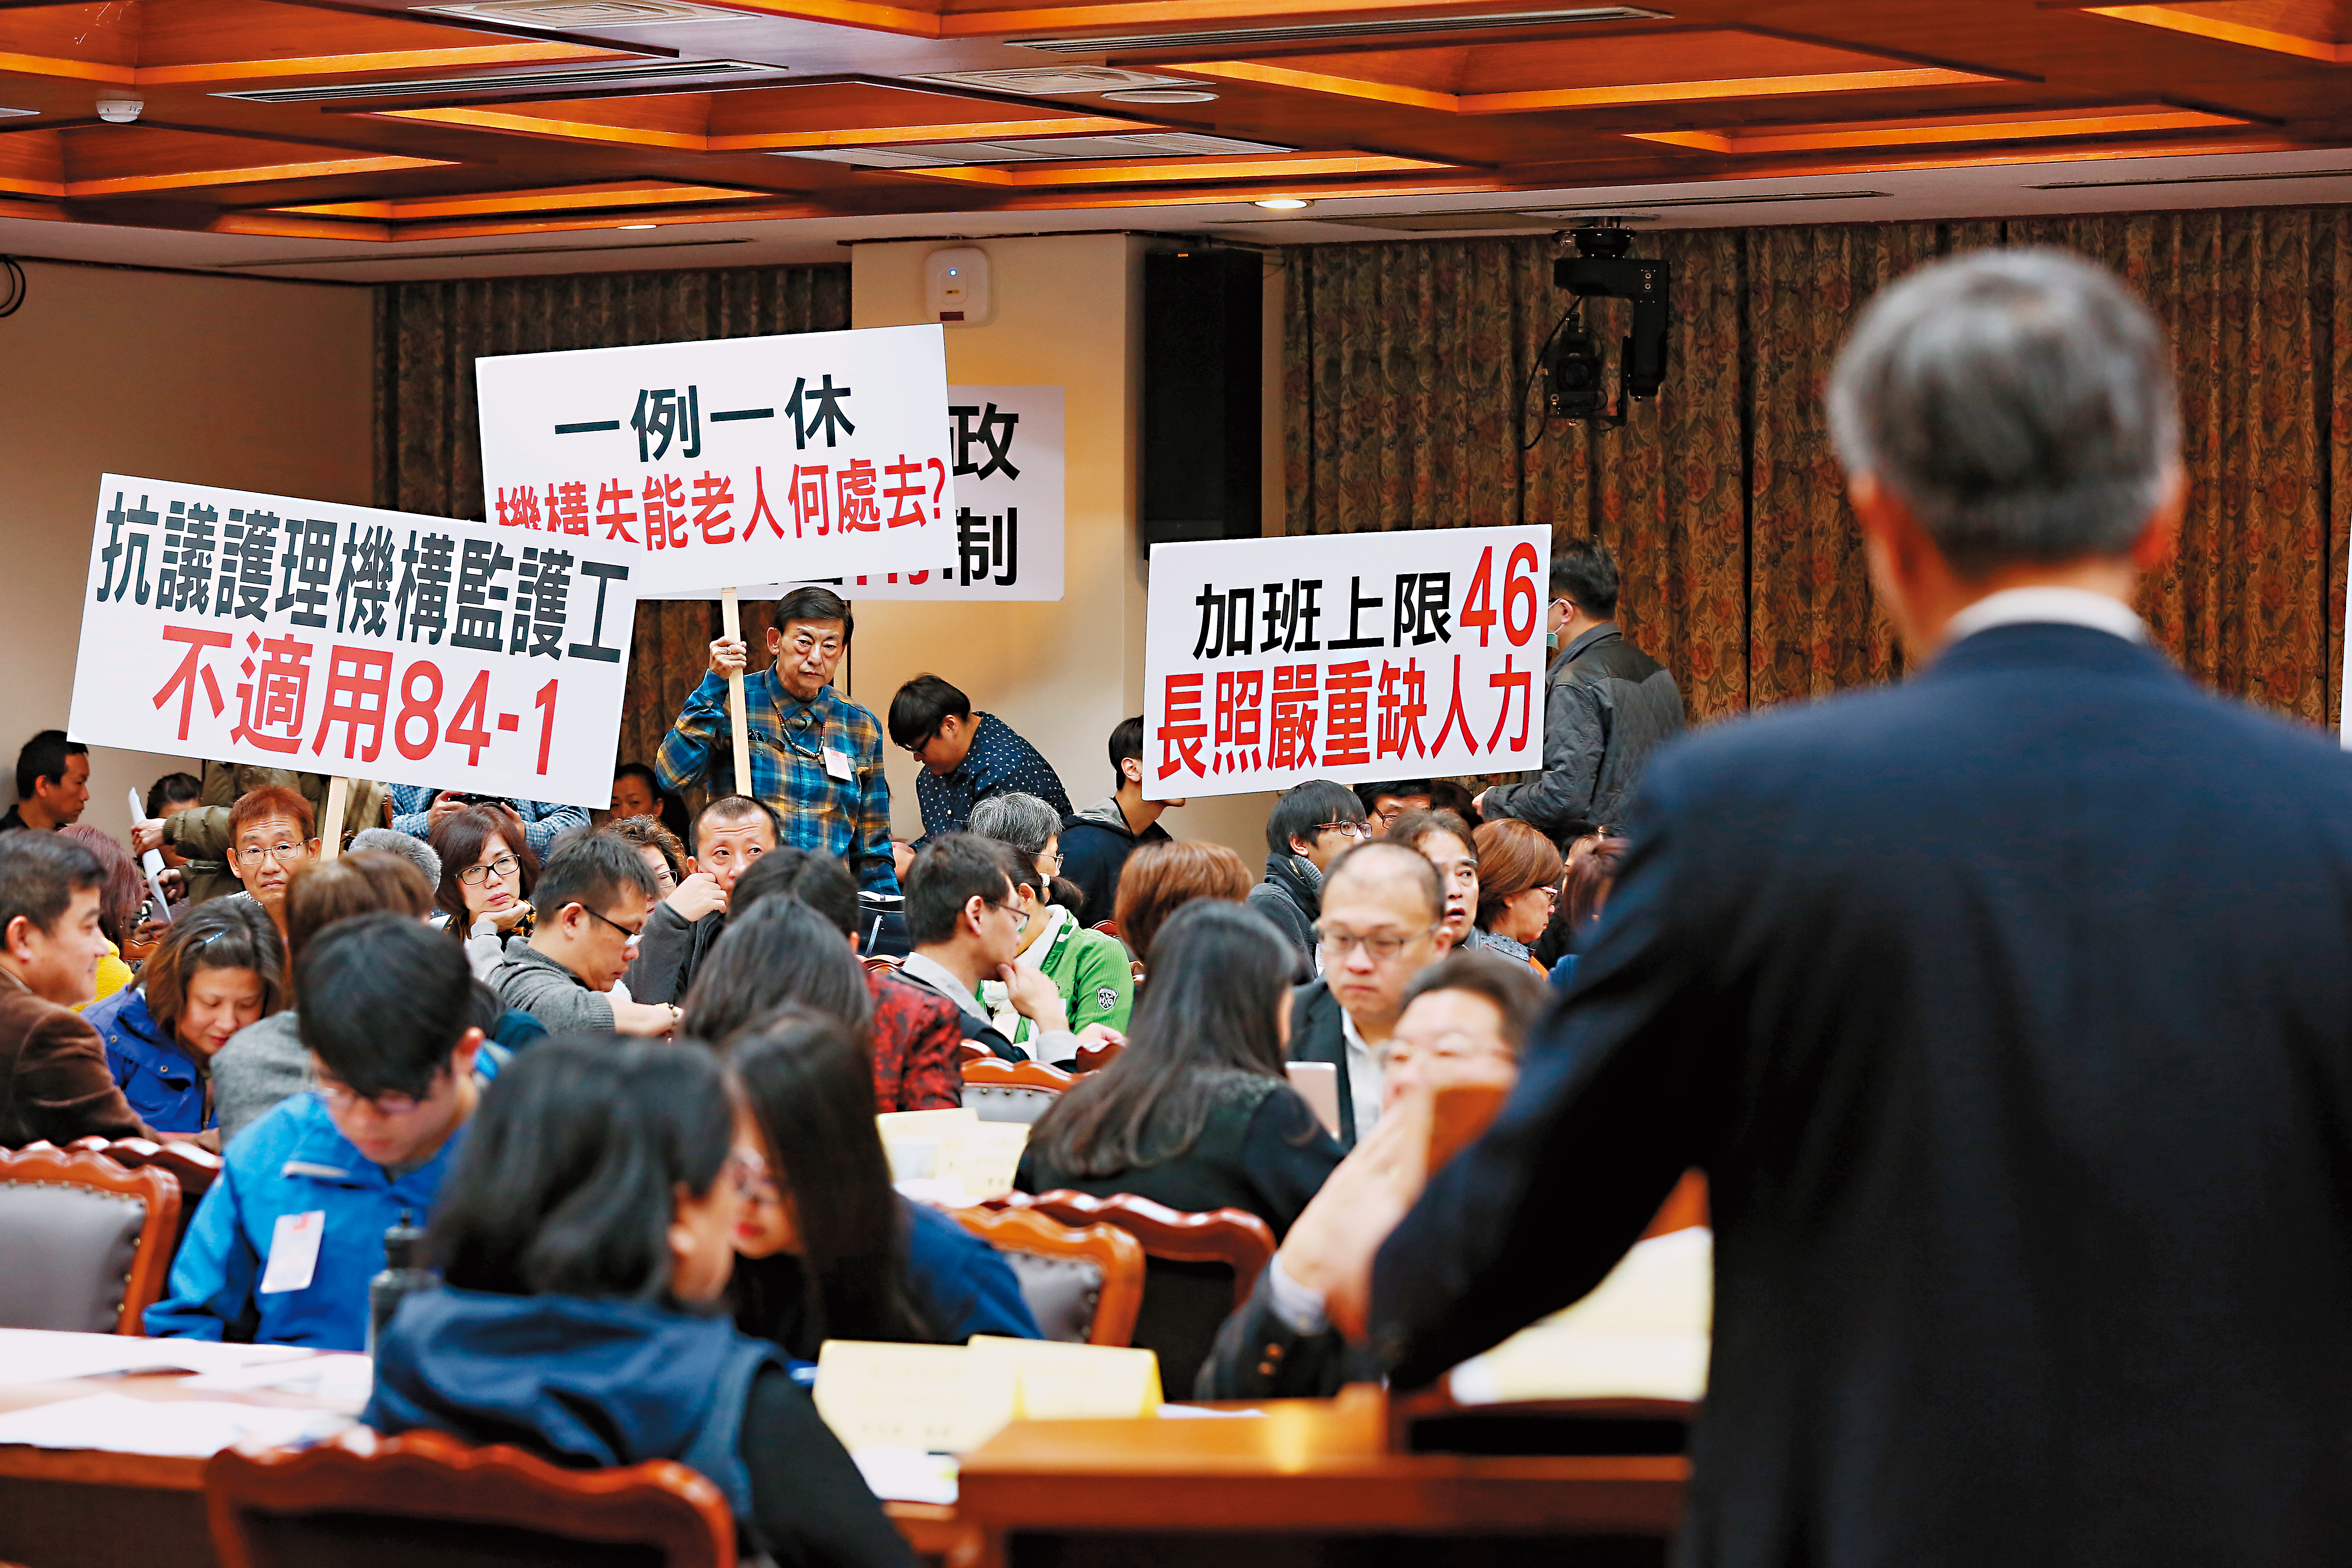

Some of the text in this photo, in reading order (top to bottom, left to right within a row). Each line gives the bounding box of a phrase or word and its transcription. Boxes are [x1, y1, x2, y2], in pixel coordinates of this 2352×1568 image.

[555, 374, 855, 462] 一例一休
[496, 454, 944, 550] 機構失能老人何處去?
[97, 492, 629, 663] 抗議護理機構監護工
[153, 626, 558, 775] 不適用84-1
[1158, 655, 1531, 780] 長照嚴重缺人力
